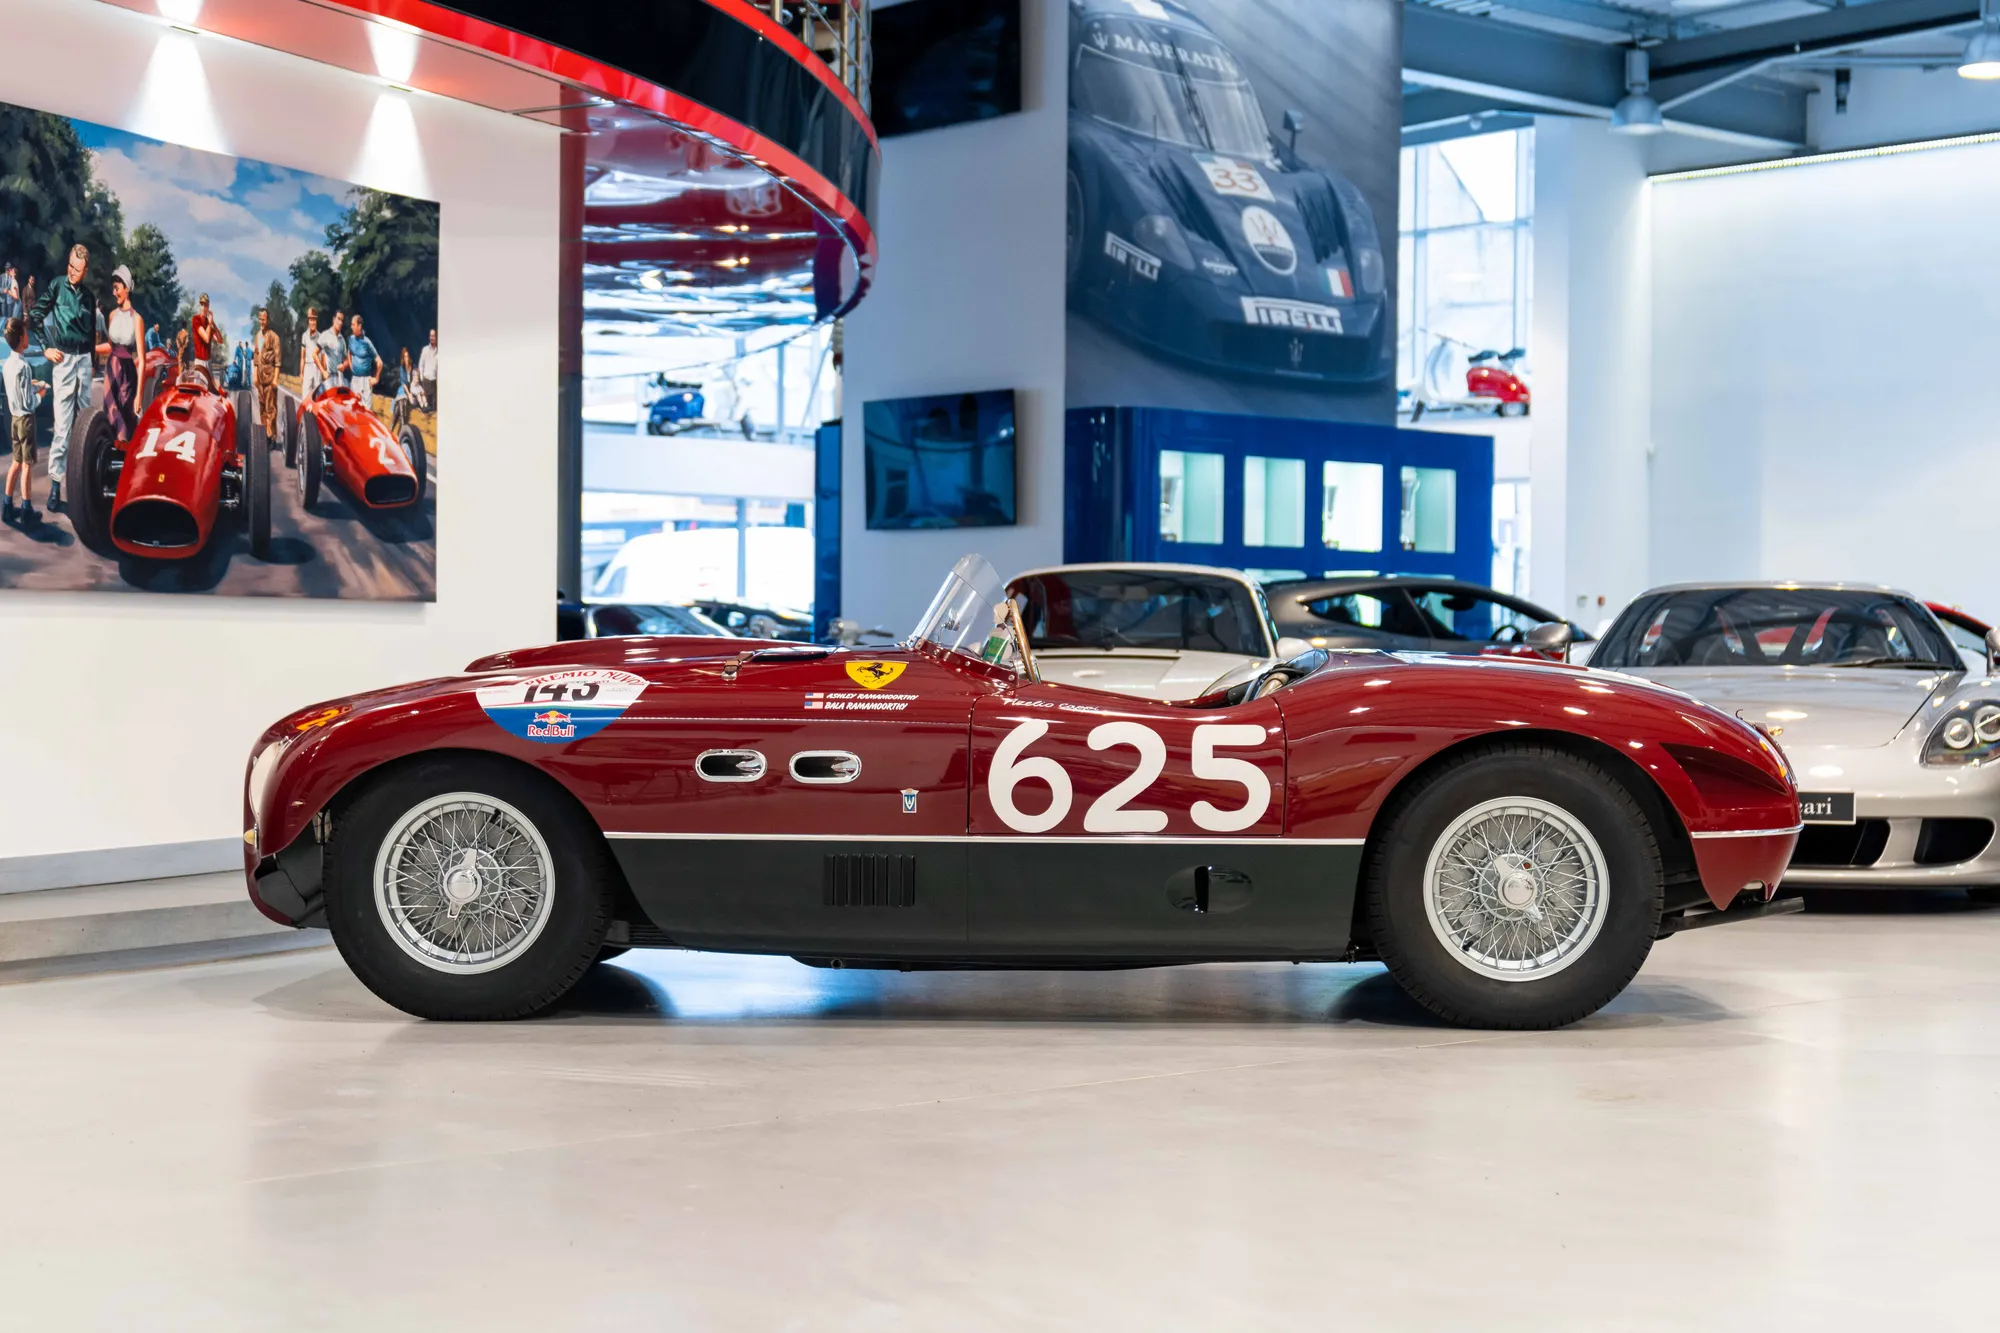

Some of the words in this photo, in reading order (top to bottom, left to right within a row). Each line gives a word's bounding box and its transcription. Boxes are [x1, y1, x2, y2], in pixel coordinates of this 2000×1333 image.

[1113, 33, 1224, 72] MASERATI
[1212, 168, 1259, 192] 33
[1104, 230, 1162, 281] PIRLLI
[1240, 296, 1343, 334] PIRELLI
[136, 428, 197, 464] 14
[369, 437, 395, 465] 2
[525, 670, 598, 686] PREMIO
[824, 701, 845, 710] BALA
[846, 701, 909, 711] RAMAMOORTHY
[826, 692, 858, 700] ASHLEY
[857, 693, 919, 701] RAMAMOORTHY
[527, 724, 551, 737] Red
[550, 724, 575, 738] Bull
[988, 719, 1271, 833] 625
[1800, 796, 1833, 815] ari
